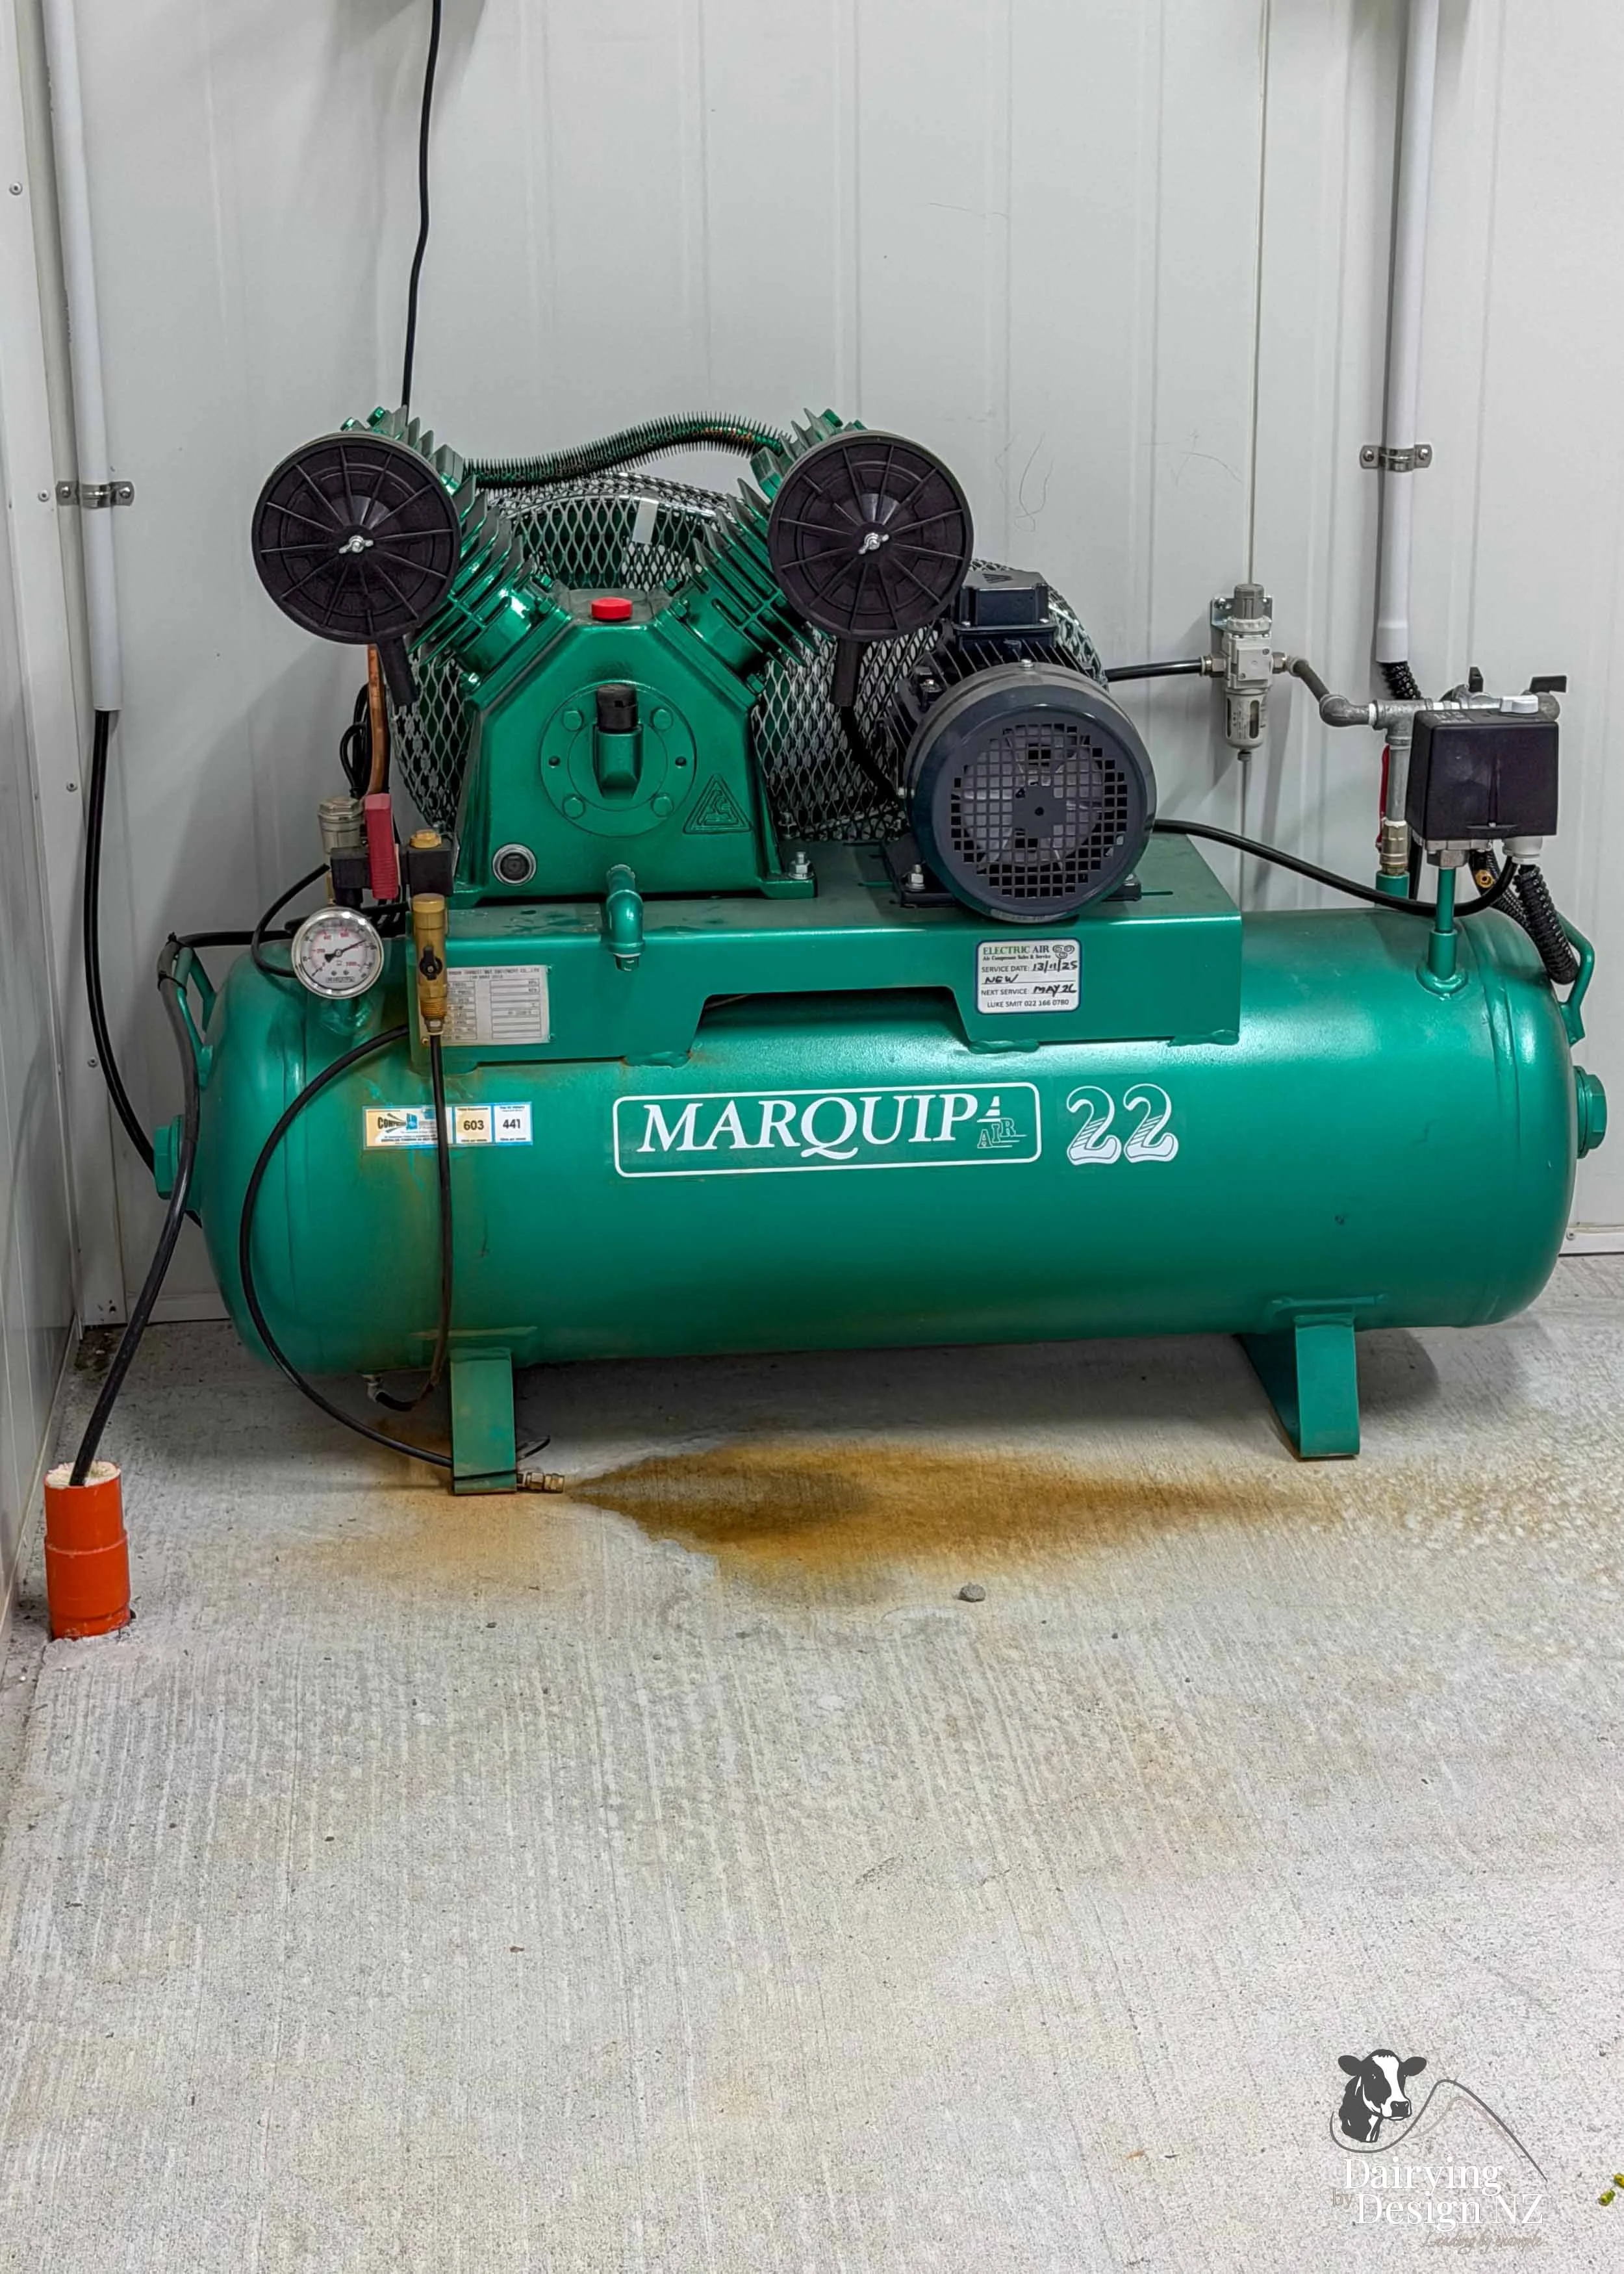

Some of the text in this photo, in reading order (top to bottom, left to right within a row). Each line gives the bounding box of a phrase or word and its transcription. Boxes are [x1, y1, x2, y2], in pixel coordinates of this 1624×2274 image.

[983, 946, 1030, 955] ELECTRIC
[1032, 960, 1078, 973] 13/11/25
[984, 974, 1019, 984] NEW
[1033, 986, 1061, 997] MAY
[463, 1119, 485, 1131] 603
[502, 1118, 521, 1129] 441
[641, 1092, 1015, 1160] MARQUIP AIR
[1065, 1084, 1179, 1166] 22
